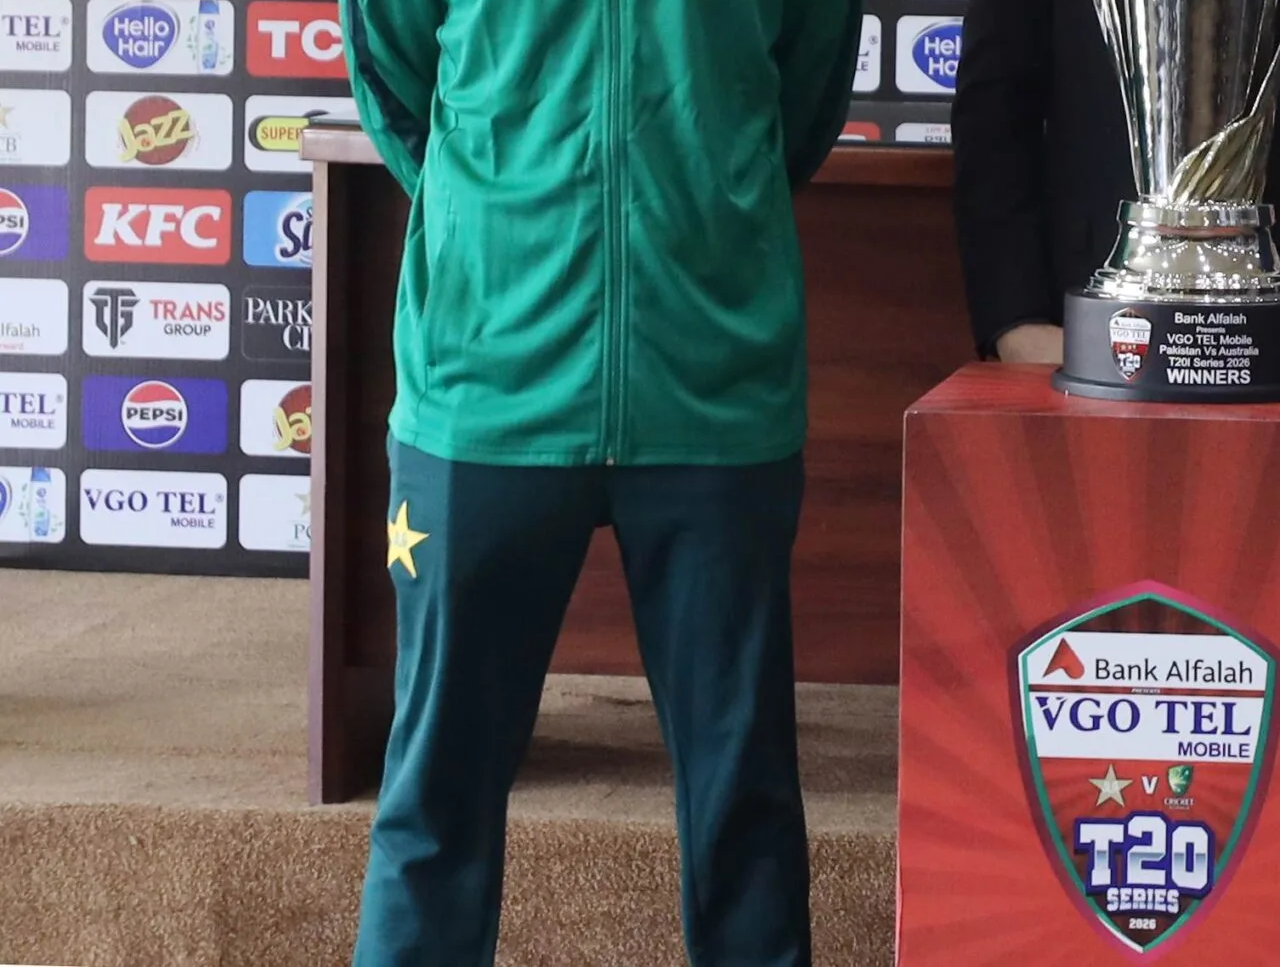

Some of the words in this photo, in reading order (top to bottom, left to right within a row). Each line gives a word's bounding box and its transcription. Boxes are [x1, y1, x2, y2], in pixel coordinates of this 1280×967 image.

[114, 17, 169, 38] Hello
[118, 38, 165, 57] Hair
[258, 19, 343, 62] TC
[94, 204, 221, 247] KFC
[149, 298, 225, 320] TRANS
[164, 322, 211, 334] GROUP
[1174, 313, 1204, 325] Bank
[1207, 313, 1247, 325] Alfalah
[1167, 334, 1193, 344] VGO
[1196, 334, 1217, 344] TEL
[1220, 334, 1253, 345] Mobile
[1160, 345, 1200, 356] Pakistan
[1204, 345, 1217, 356] Vs
[1218, 345, 1259, 356] Australia
[1193, 357, 1225, 368] Series
[1226, 358, 1250, 368] 2026
[1167, 369, 1251, 384] WINNERS
[126, 408, 183, 422] PEPSI
[84, 491, 148, 513] VGO
[170, 517, 215, 528] MOBILE
[1095, 658, 1159, 682] Bank
[1166, 659, 1252, 684] Alfalah
[1035, 696, 1140, 733] VGO
[1154, 699, 1252, 736] TEL
[1178, 741, 1250, 758] MOBILE
[1079, 815, 1209, 890] T20
[1106, 887, 1179, 914] SERIES
[1129, 918, 1157, 930] 2026
